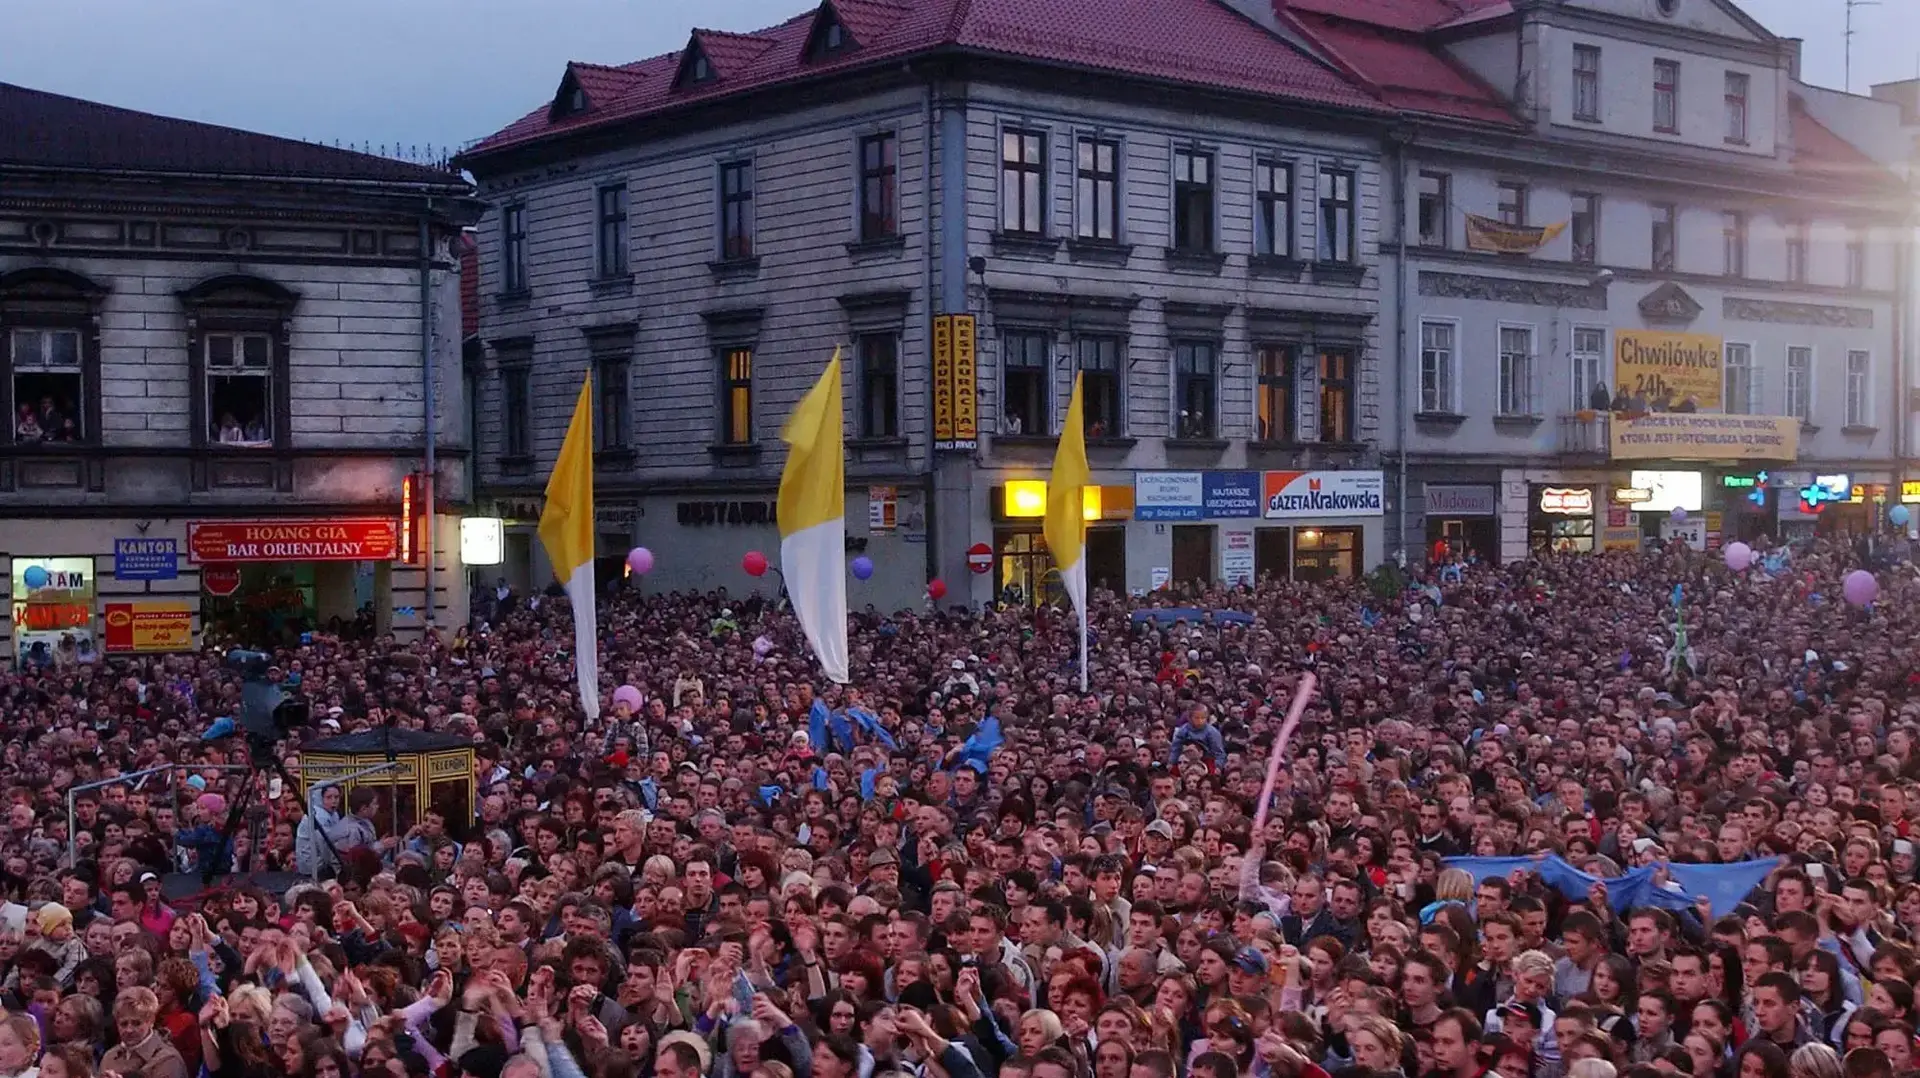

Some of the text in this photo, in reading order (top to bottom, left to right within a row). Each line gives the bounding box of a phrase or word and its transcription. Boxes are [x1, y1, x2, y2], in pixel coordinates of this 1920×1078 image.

[1620, 337, 1718, 369] Chwilówka
[936, 319, 949, 425] RESTAURACJA
[957, 319, 972, 425] RESTAURACJA
[1654, 432, 1673, 444] JEST
[1270, 491, 1380, 510] GAZETA Krakowska
[1428, 491, 1486, 509] Madonna
[246, 526, 348, 540] HOANG GIA
[119, 541, 174, 554] KANTOR
[227, 543, 259, 556] BAR
[263, 542, 364, 556] ORIENTALNY
[430, 759, 466, 772] TELEFON
